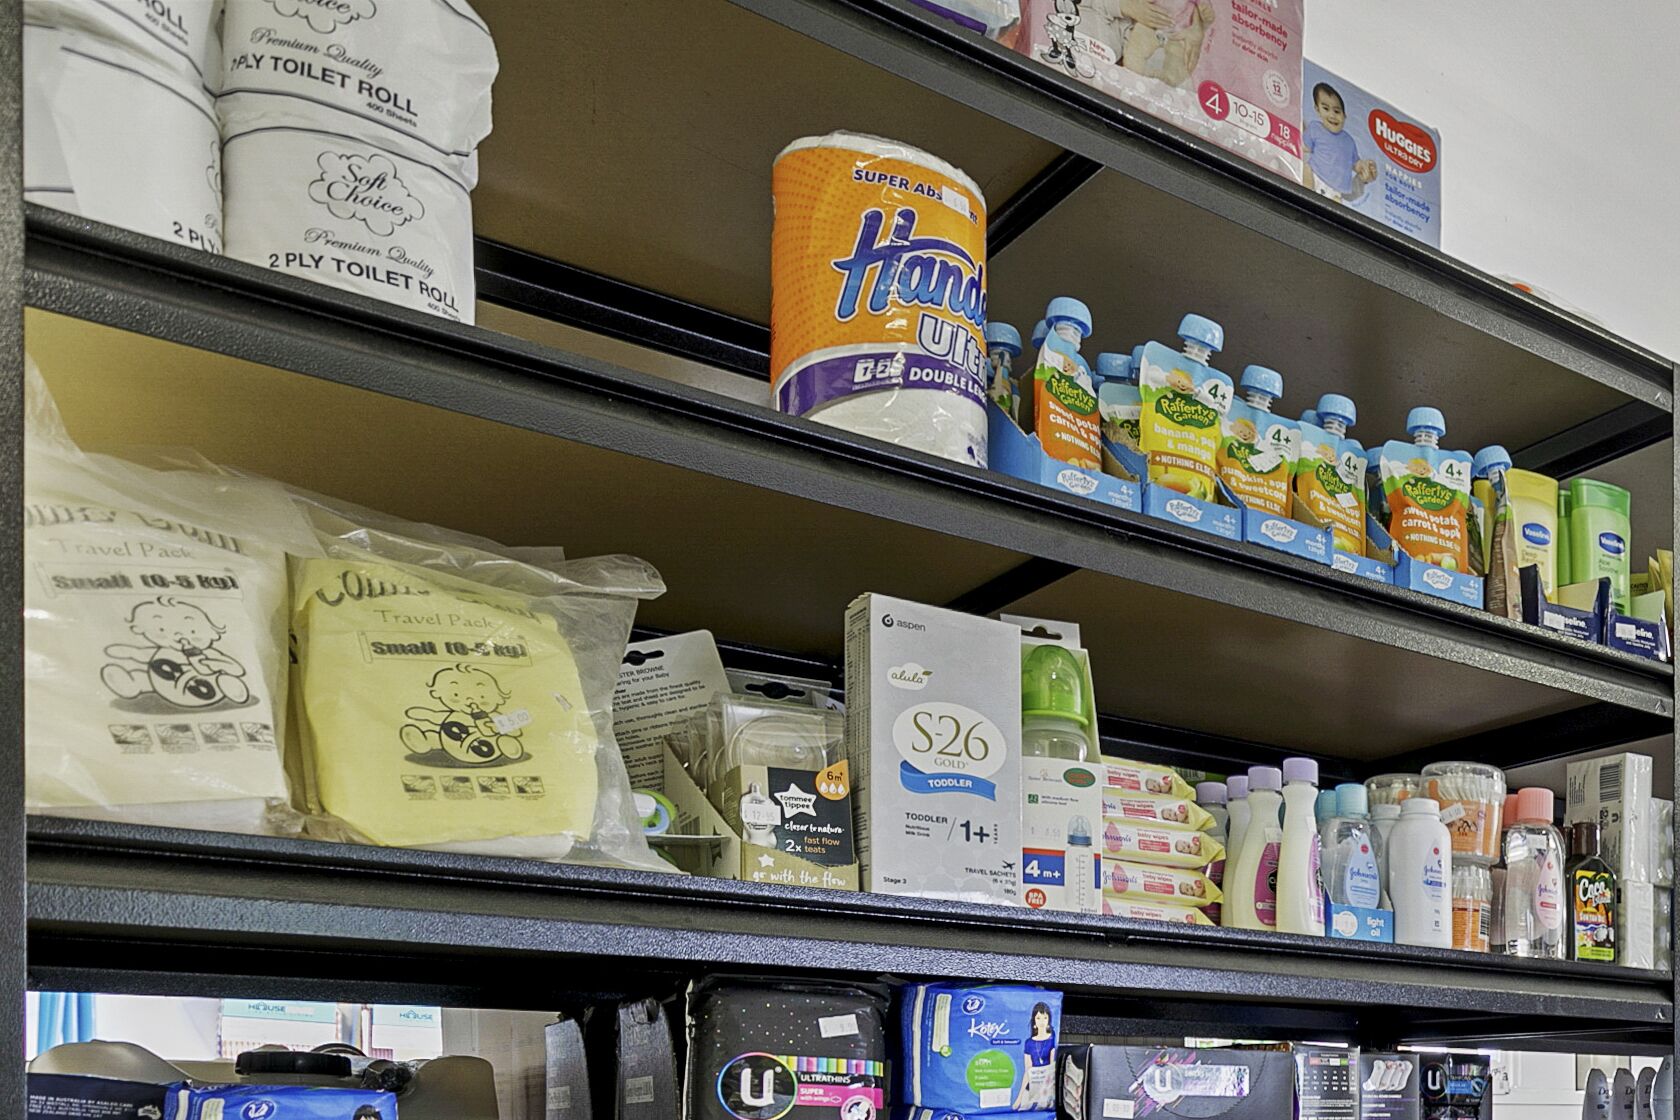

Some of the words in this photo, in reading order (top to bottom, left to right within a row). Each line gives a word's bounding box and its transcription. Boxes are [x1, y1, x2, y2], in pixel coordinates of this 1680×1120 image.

[250, 27, 318, 54] Premium
[323, 43, 384, 79] Quality
[270, 55, 352, 88] TOILET
[357, 79, 419, 117] ROLL
[1205, 93, 1223, 115] 4
[1233, 101, 1265, 127] 10-15
[1278, 123, 1291, 140] 18
[1375, 118, 1431, 165] HUGGIES
[341, 163, 390, 192] Soft
[326, 181, 405, 216] Choice
[304, 228, 382, 256] Premium
[387, 246, 435, 278] Quality
[269, 254, 280, 268] 2
[285, 252, 325, 270] PLY
[331, 257, 413, 290] TOILET
[418, 280, 460, 313] ROLL
[1051, 376, 1095, 408] Rafferty's
[1161, 398, 1217, 423] Rafferty's
[1173, 411, 1211, 426] Garden
[1445, 463, 1464, 477] 4+
[1405, 484, 1453, 502] Rafferty's
[1524, 526, 1550, 541] Vaseline
[373, 609, 442, 626] Travel
[449, 614, 497, 630] Pack
[896, 619, 926, 633] aspen
[891, 669, 924, 685] alula
[911, 711, 989, 761] S-26
[934, 757, 967, 770] GOLD
[927, 778, 975, 789] TODDLER
[779, 795, 813, 804] tommee
[784, 800, 812, 812] tippee
[904, 812, 949, 826] TODDLER
[804, 836, 820, 846] fast
[821, 836, 841, 846] flow
[960, 820, 990, 845] 1+
[785, 838, 802, 853] 2x
[804, 845, 826, 854] teats
[1024, 860, 1041, 879] 4
[1042, 869, 1062, 880] m+
[1579, 878, 1607, 902] Coco
[1366, 917, 1385, 929] light
[1370, 926, 1381, 937] oil
[967, 1017, 1009, 1038] Kotex
[800, 1074, 851, 1085] ULTRATHINS
[799, 1087, 825, 1096] SUPER
